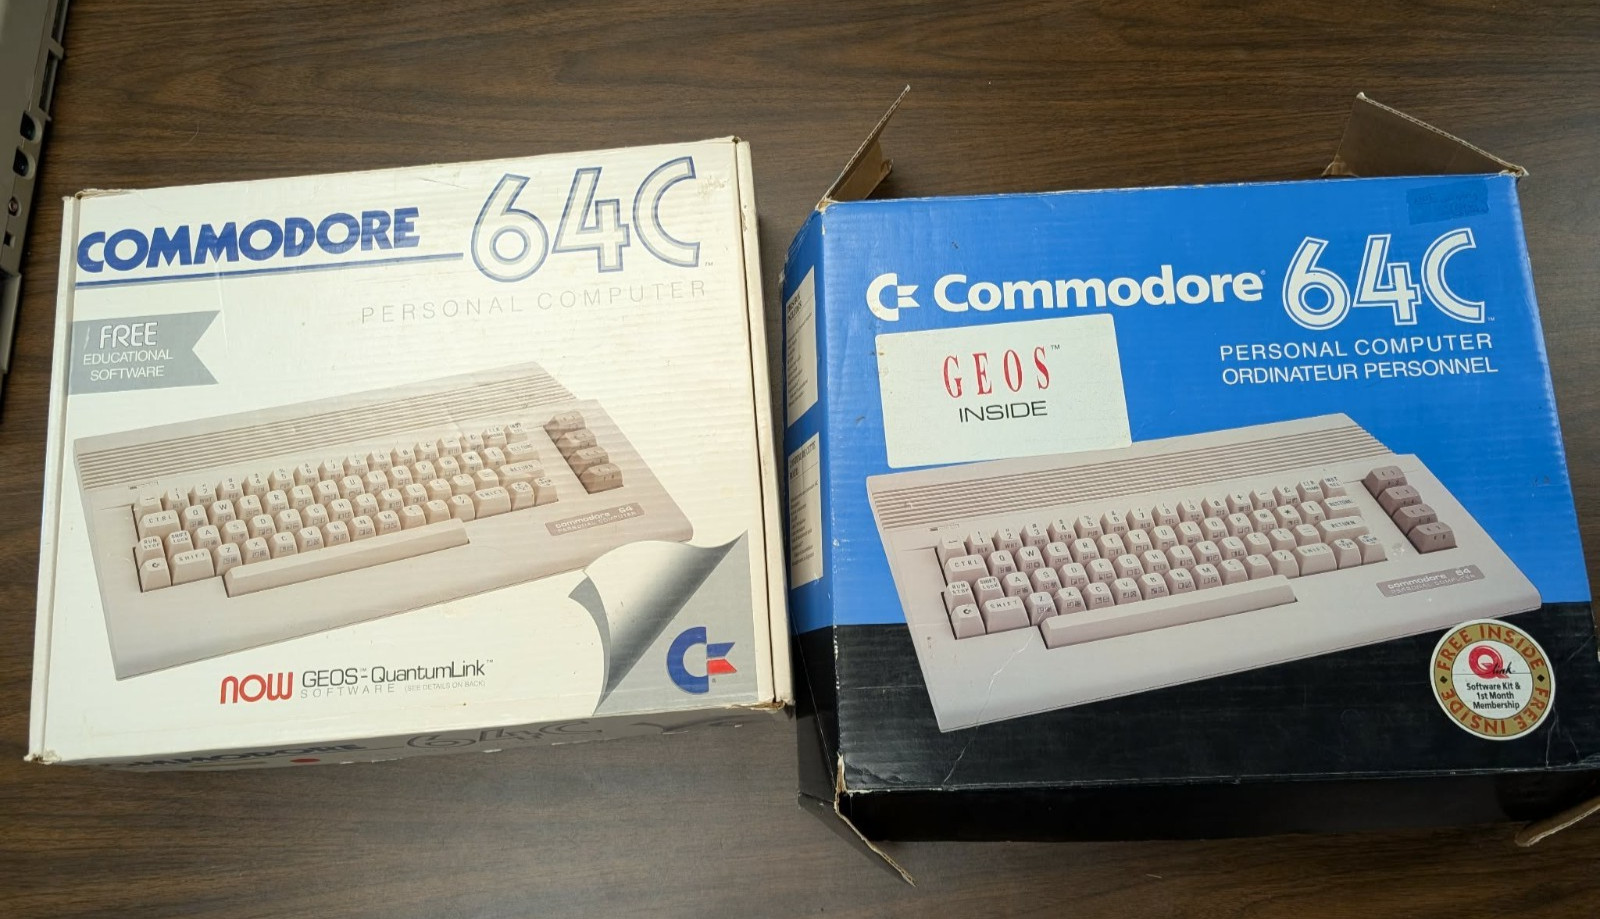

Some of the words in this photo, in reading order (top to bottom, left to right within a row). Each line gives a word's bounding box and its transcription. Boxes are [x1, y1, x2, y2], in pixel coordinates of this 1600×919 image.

[77, 207, 420, 273] COMMODORE
[471, 156, 701, 282] 64C
[934, 264, 1263, 312] Commodore
[1282, 228, 1485, 330] 64C
[361, 295, 523, 324] PERSONAL
[537, 279, 706, 310] COMPUTER
[99, 321, 158, 349] FREE
[1219, 340, 1347, 361] PERSONAL
[1354, 333, 1493, 356] COMPUTER
[83, 349, 173, 366] EDUCATIONAL
[1222, 363, 1357, 385] ORDINATEUR
[1365, 357, 1498, 379] PERSONNEL
[89, 365, 165, 381] SOFTWARE
[959, 400, 1047, 423] INSIDE
[1388, 574, 1447, 589] commodore
[1437, 629, 1473, 671] FREE
[1479, 624, 1544, 671] INSIDE
[300, 683, 395, 699] SOFTWARE
[1466, 682, 1501, 691] Software
[1502, 681, 1513, 690] Kit
[1515, 682, 1521, 690] &
[1477, 692, 1488, 700] 1st
[1489, 691, 1514, 700] Month
[1441, 688, 1506, 734] INSIDE
[1473, 701, 1520, 711] Membership
[1514, 687, 1549, 730] FREE
